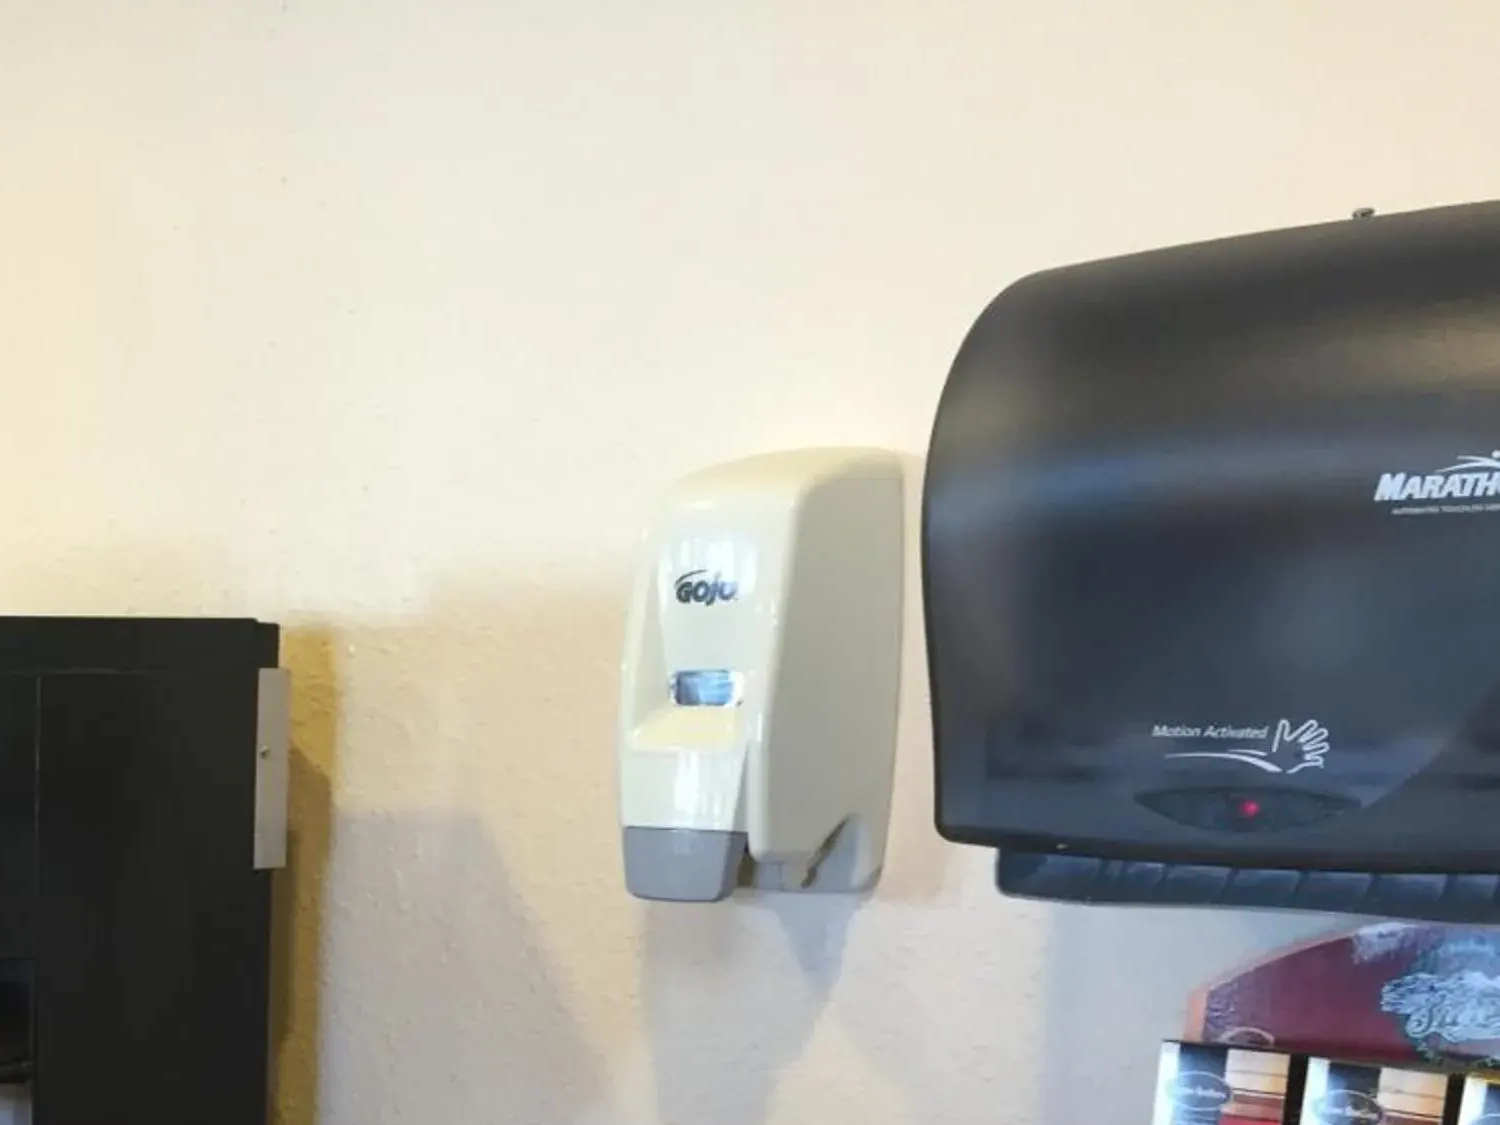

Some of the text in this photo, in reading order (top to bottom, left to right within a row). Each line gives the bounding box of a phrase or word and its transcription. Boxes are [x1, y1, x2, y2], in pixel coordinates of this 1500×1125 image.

[1373, 470, 1500, 502] MARATH
[675, 573, 738, 606] GOJO
[1152, 725, 1269, 739] Motion Activated
